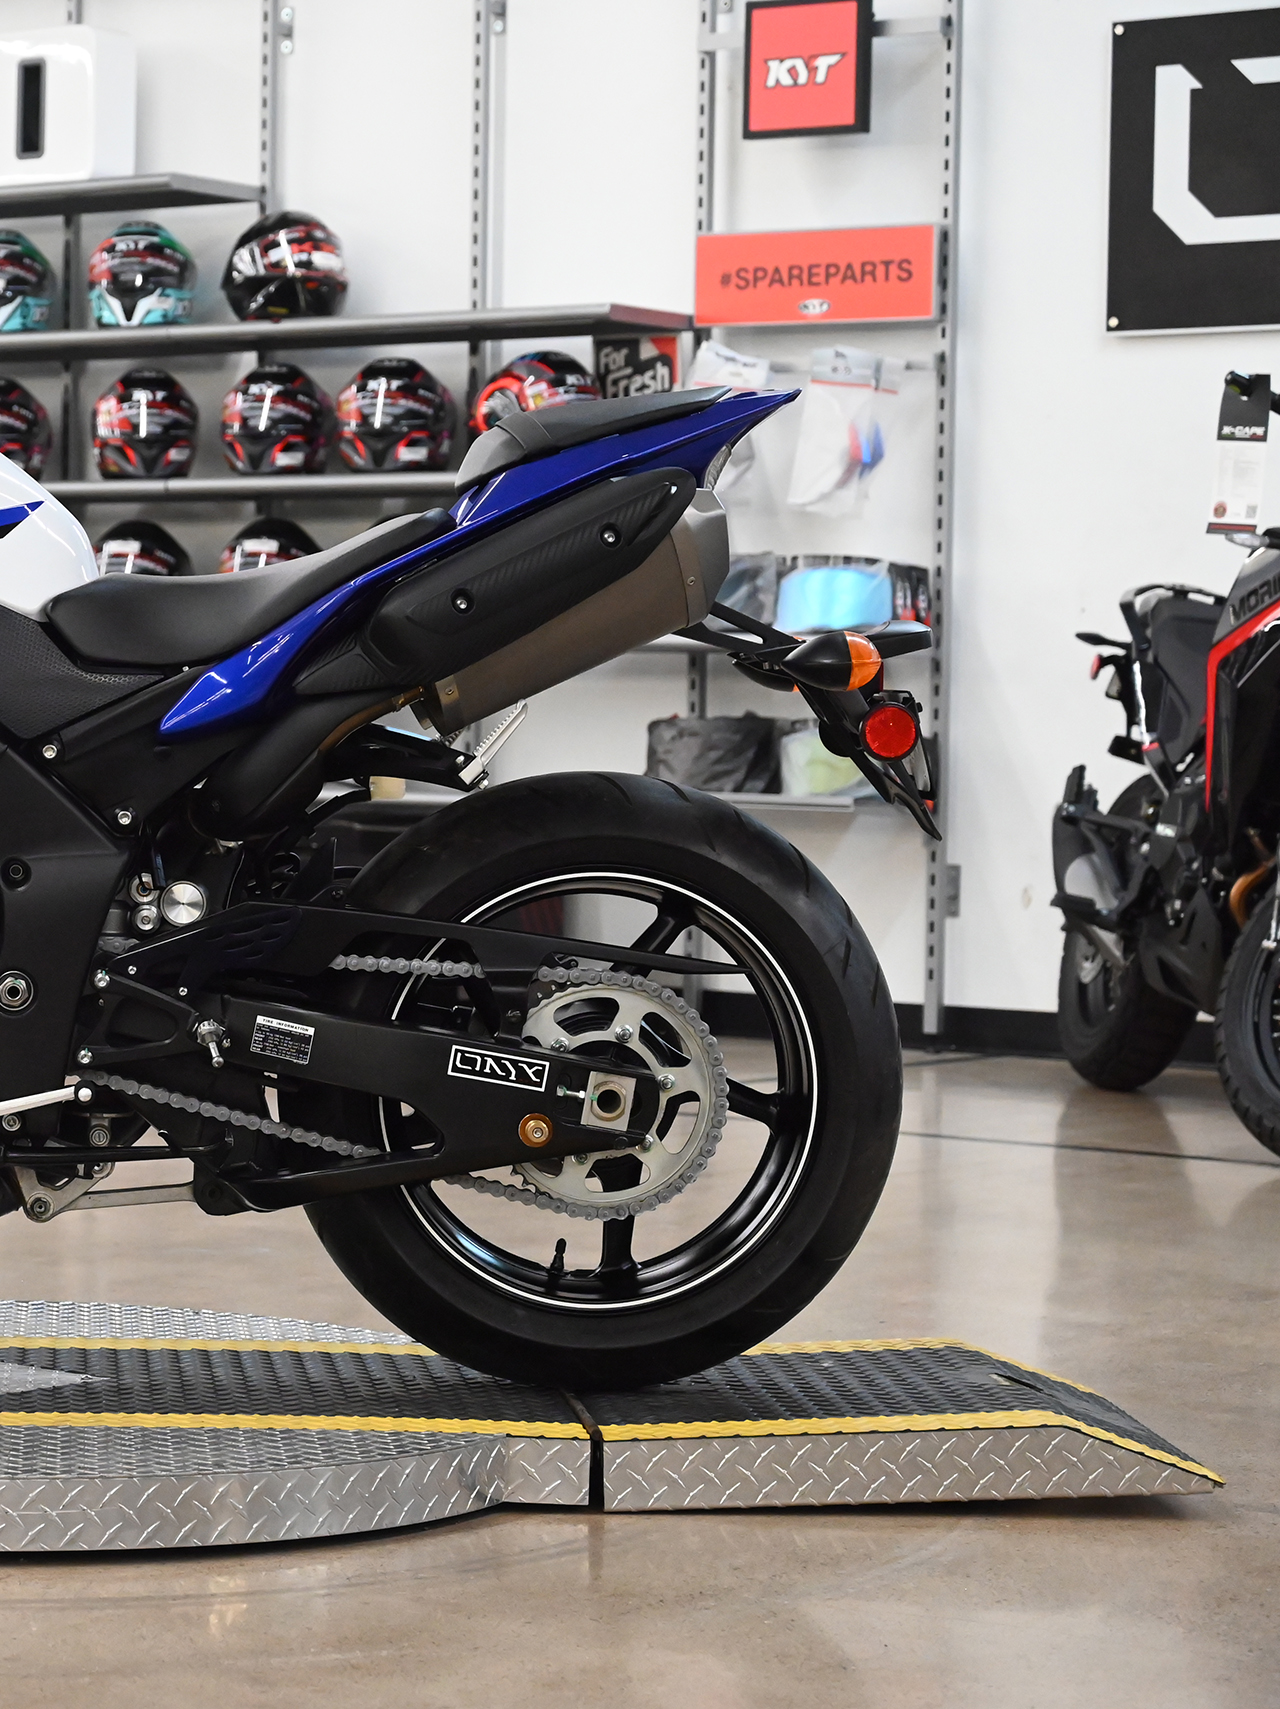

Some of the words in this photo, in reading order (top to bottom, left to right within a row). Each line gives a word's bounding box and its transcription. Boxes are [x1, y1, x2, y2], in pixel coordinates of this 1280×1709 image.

[764, 52, 847, 89] KYT
[720, 258, 914, 290] #SPAREPARTS
[598, 345, 629, 373] For
[606, 361, 671, 399] Fresh
[1229, 575, 1280, 626] MORI
[455, 1052, 543, 1082] ONYX
